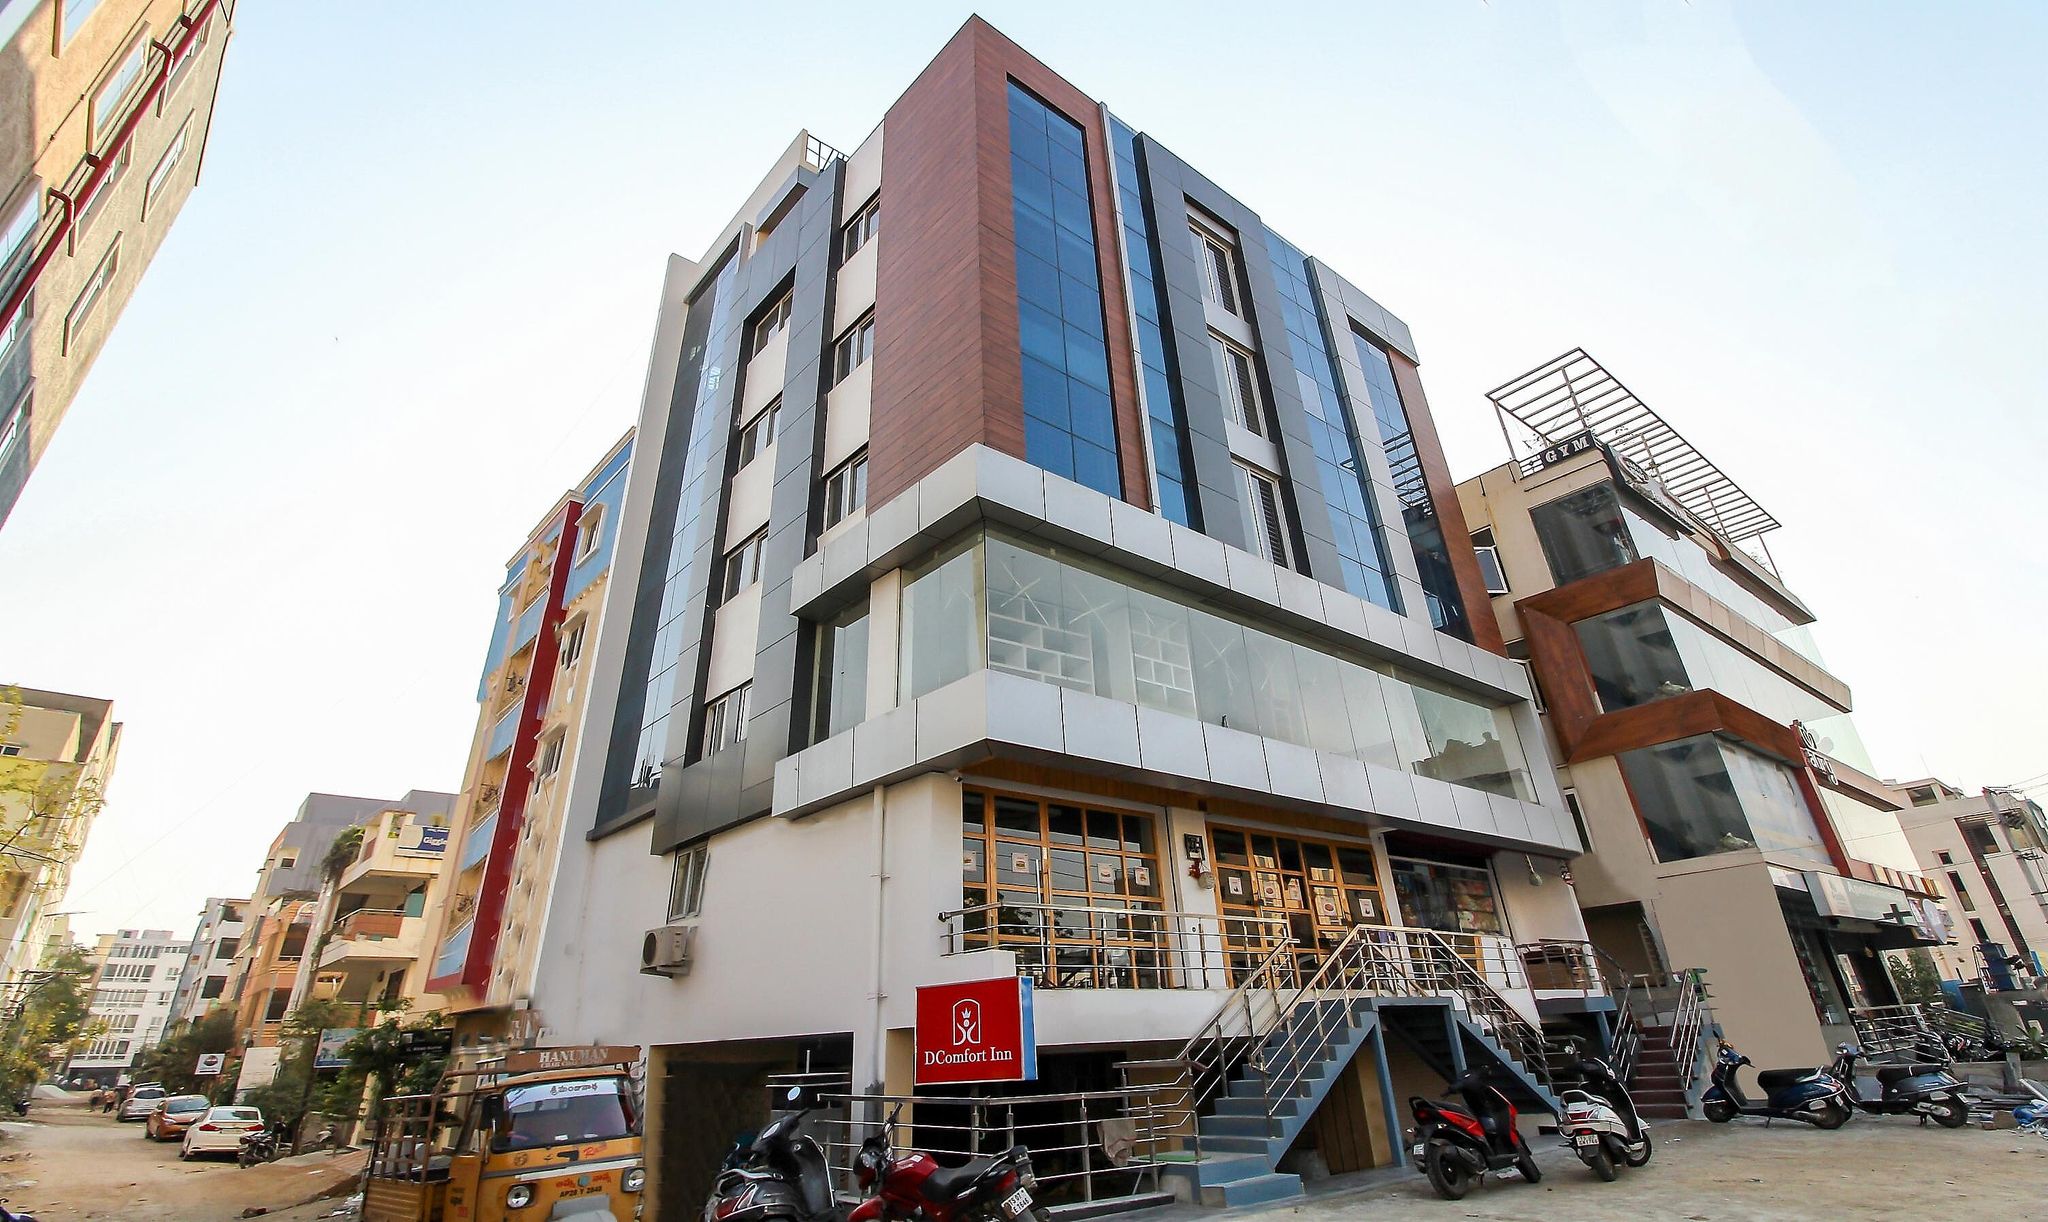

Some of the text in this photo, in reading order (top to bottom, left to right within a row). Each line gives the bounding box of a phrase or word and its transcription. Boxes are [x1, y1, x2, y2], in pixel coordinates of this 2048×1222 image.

[1545, 437, 1589, 462] GYM
[924, 1046, 1013, 1065] DComfort Inn
